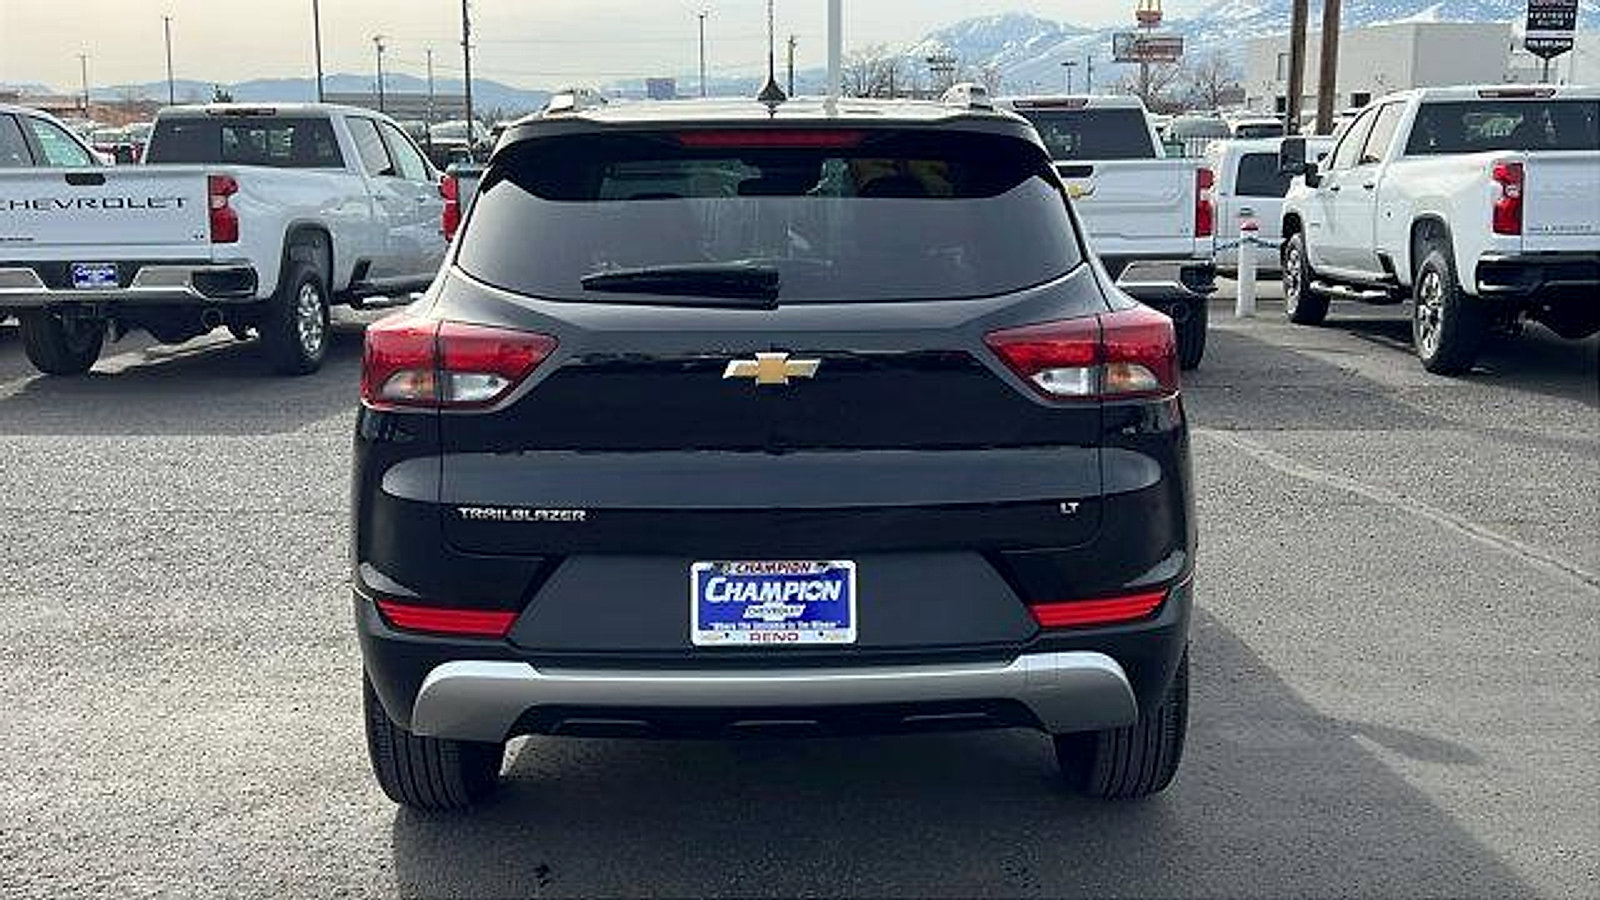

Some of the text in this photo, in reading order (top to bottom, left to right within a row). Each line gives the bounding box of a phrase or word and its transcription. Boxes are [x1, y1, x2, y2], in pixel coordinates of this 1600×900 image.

[458, 507, 587, 521] TRAILBLAZER
[1060, 502, 1079, 514] LT
[736, 561, 811, 574] CHAMPION
